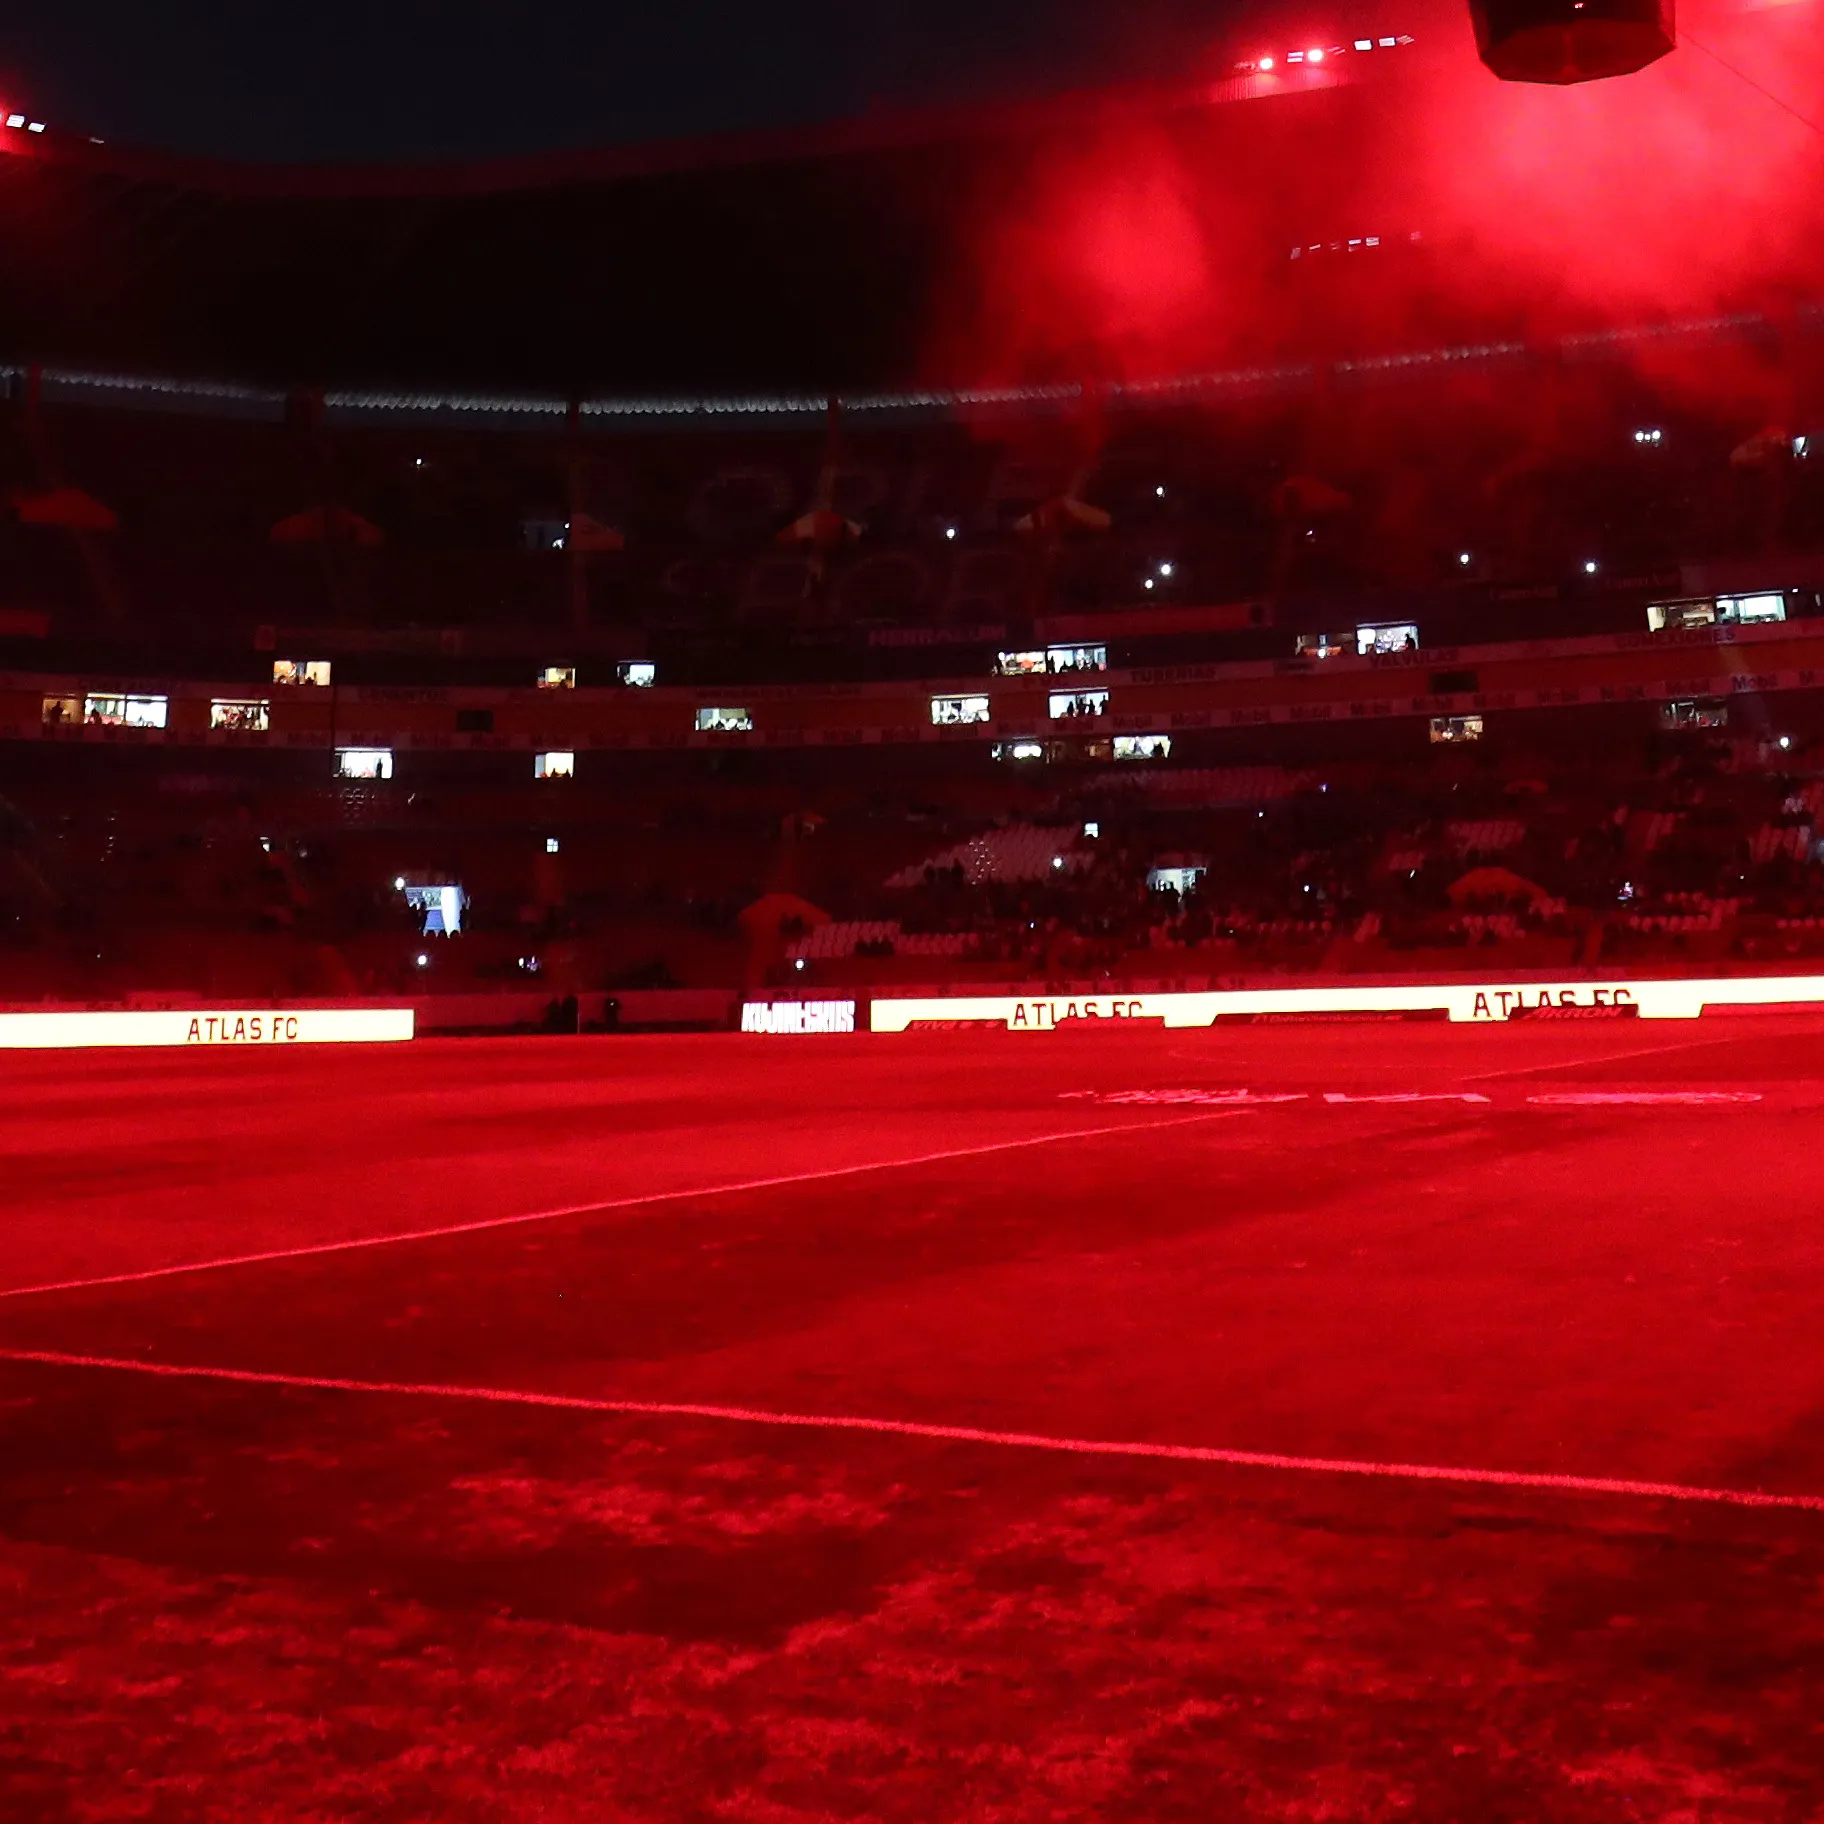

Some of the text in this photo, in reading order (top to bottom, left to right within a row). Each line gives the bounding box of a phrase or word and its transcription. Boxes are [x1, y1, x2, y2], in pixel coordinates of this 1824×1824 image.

[1013, 1002, 1098, 1026] ATLAS
[188, 1017, 298, 1041] ATLAS FC
